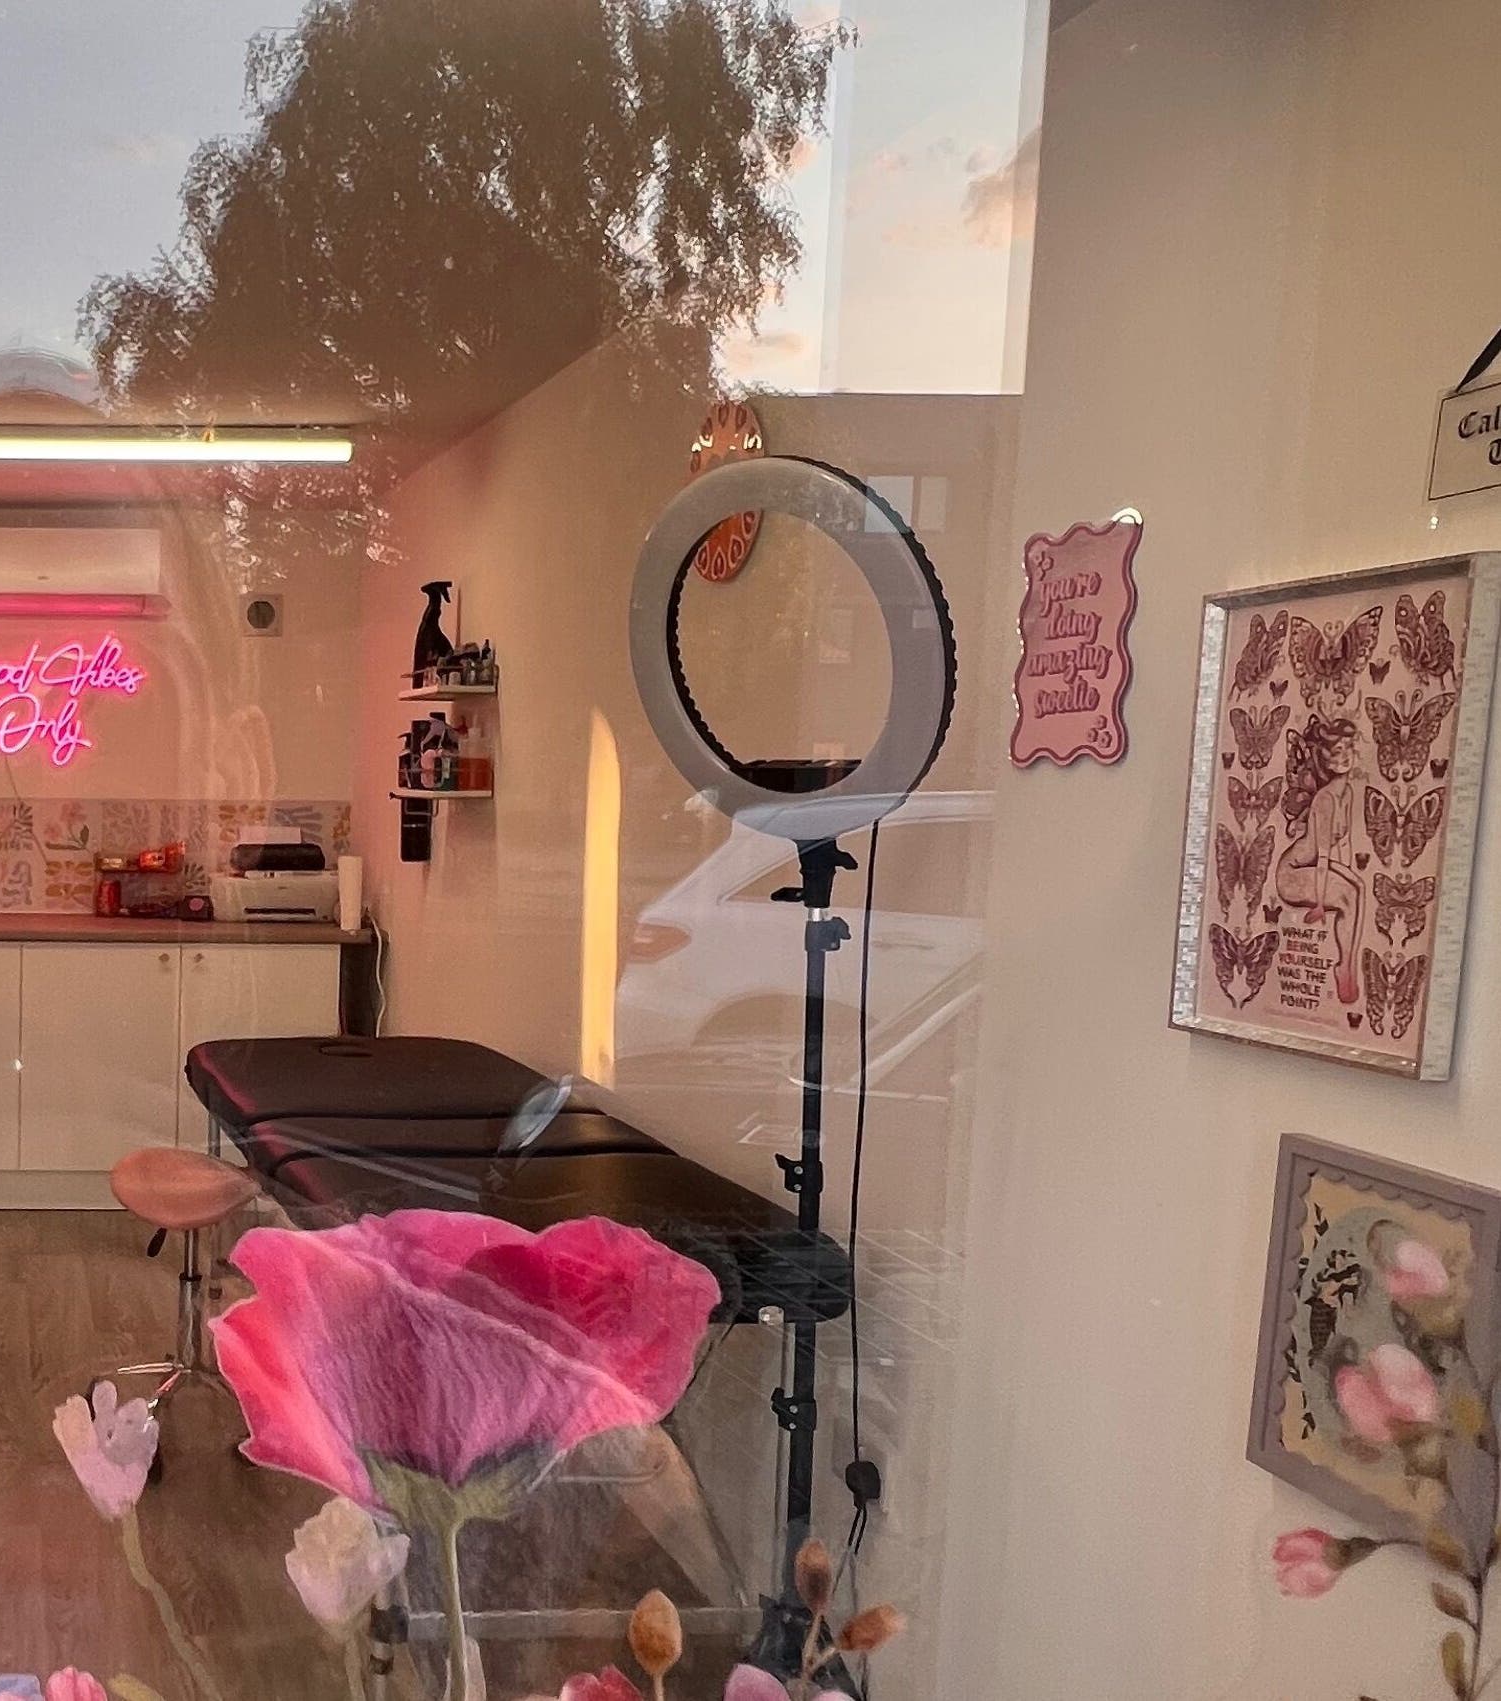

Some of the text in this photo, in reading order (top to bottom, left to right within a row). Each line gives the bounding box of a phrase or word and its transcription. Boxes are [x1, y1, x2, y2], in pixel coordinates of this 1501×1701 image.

[39, 632, 143, 696] Vibes
[1279, 953, 1334, 970] YOURSELF
[1305, 970, 1327, 984] THE
[1280, 981, 1321, 998] WHOLE
